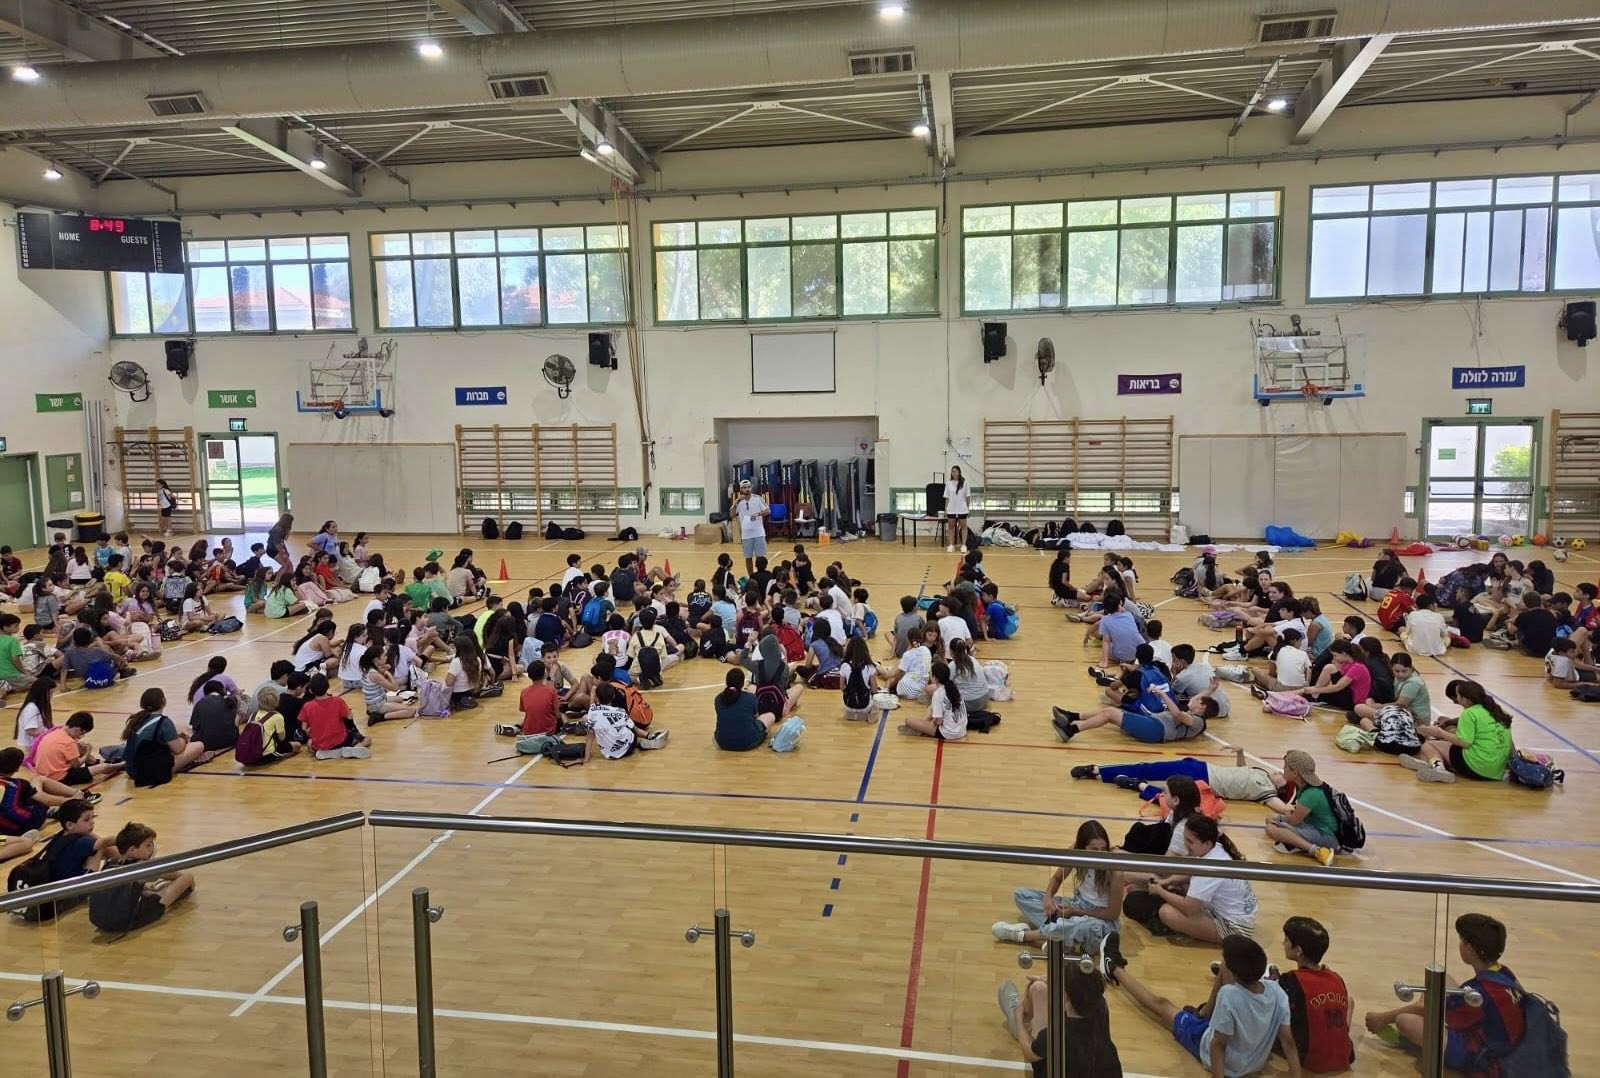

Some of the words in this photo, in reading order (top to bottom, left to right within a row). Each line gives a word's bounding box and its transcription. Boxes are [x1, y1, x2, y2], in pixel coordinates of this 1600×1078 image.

[58, 231, 80, 242] HOME
[121, 235, 148, 245] GUESTS
[1459, 369, 1489, 384] לזולת
[1491, 371, 1517, 383] עזרה
[1129, 379, 1160, 390] בריאות
[466, 391, 489, 401] חברות
